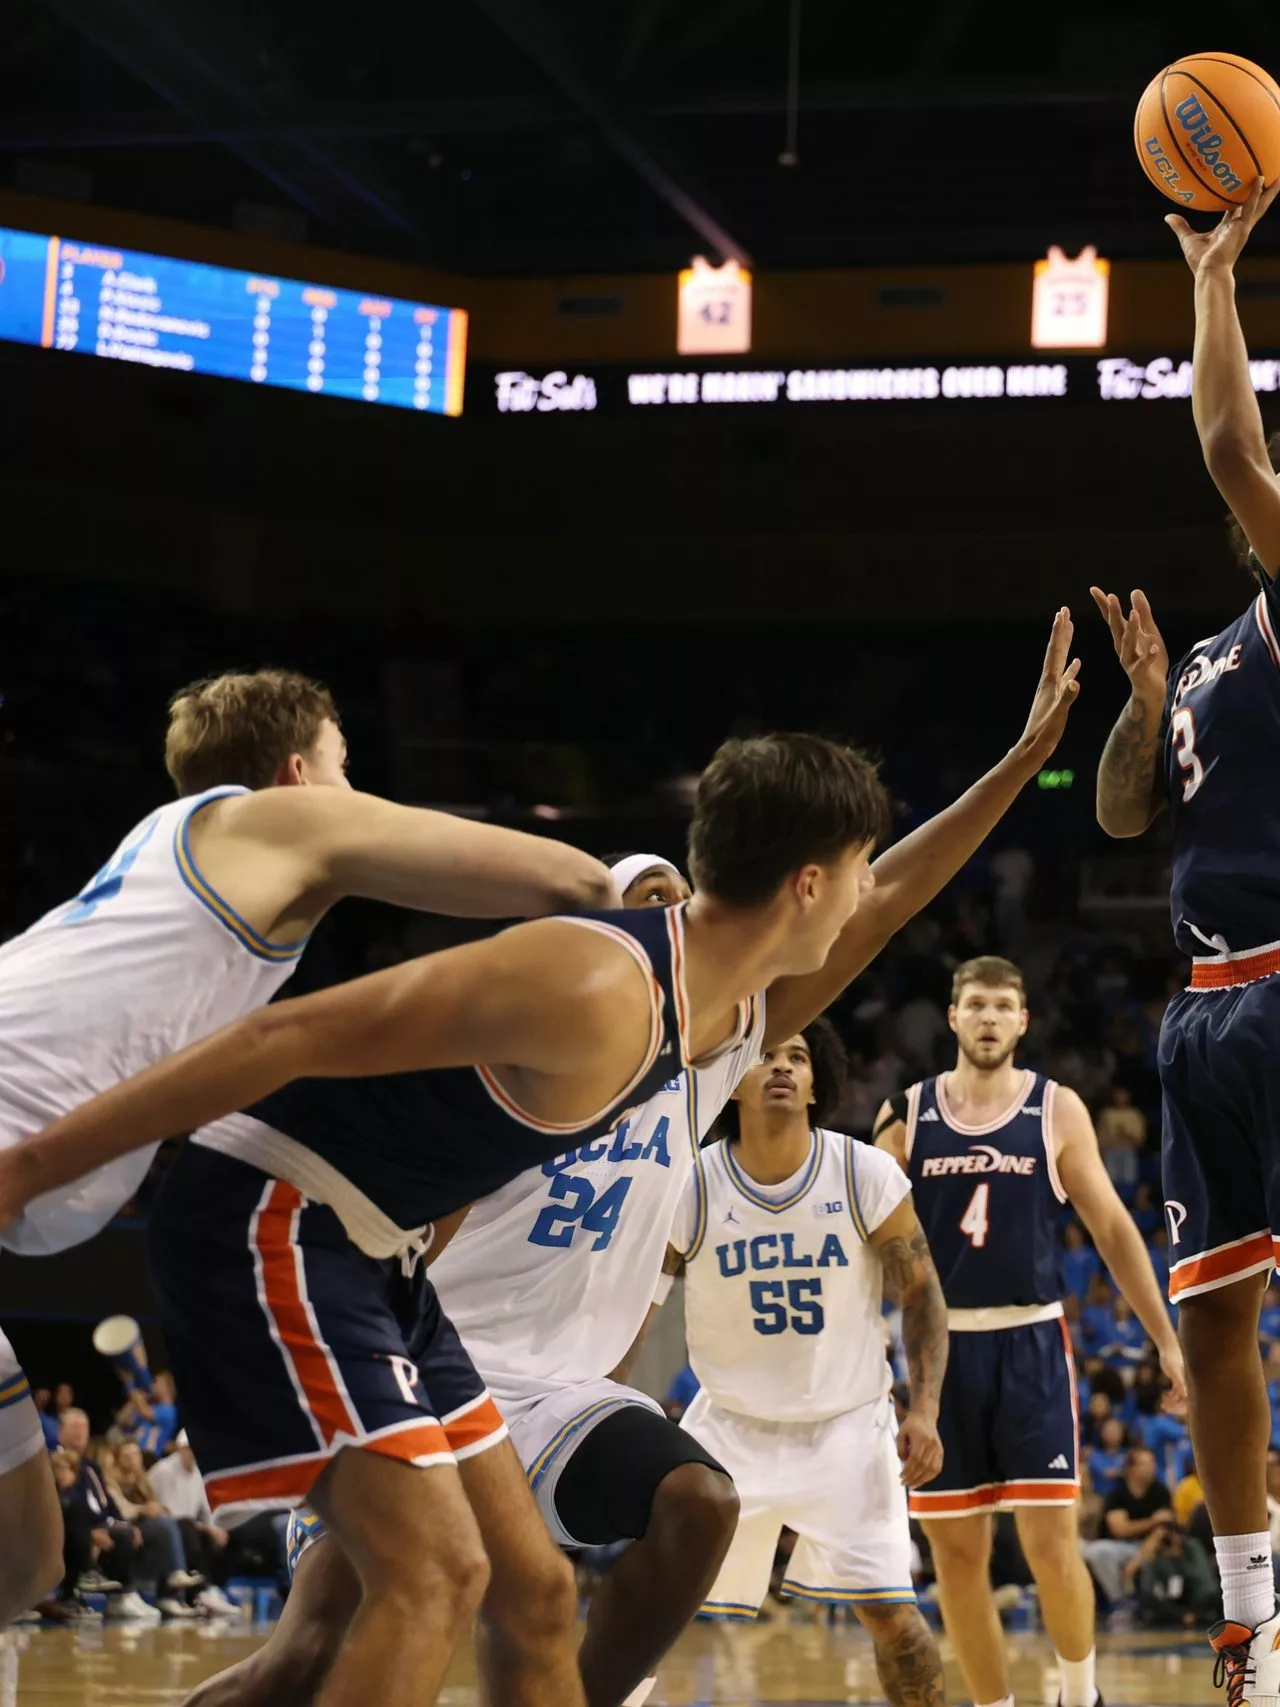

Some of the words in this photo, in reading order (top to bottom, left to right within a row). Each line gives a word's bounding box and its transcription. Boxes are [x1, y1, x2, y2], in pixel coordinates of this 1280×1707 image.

[1145, 136, 1196, 204] UCLA
[1175, 92, 1242, 193] Wilson
[699, 301, 731, 326] 42
[1172, 706, 1204, 803] 3
[922, 1144, 1037, 1178] PEPPERDINE
[527, 1173, 634, 1252] 24
[960, 1182, 989, 1248] 4
[715, 1233, 849, 1278] UCLA
[749, 1278, 825, 1335] 55
